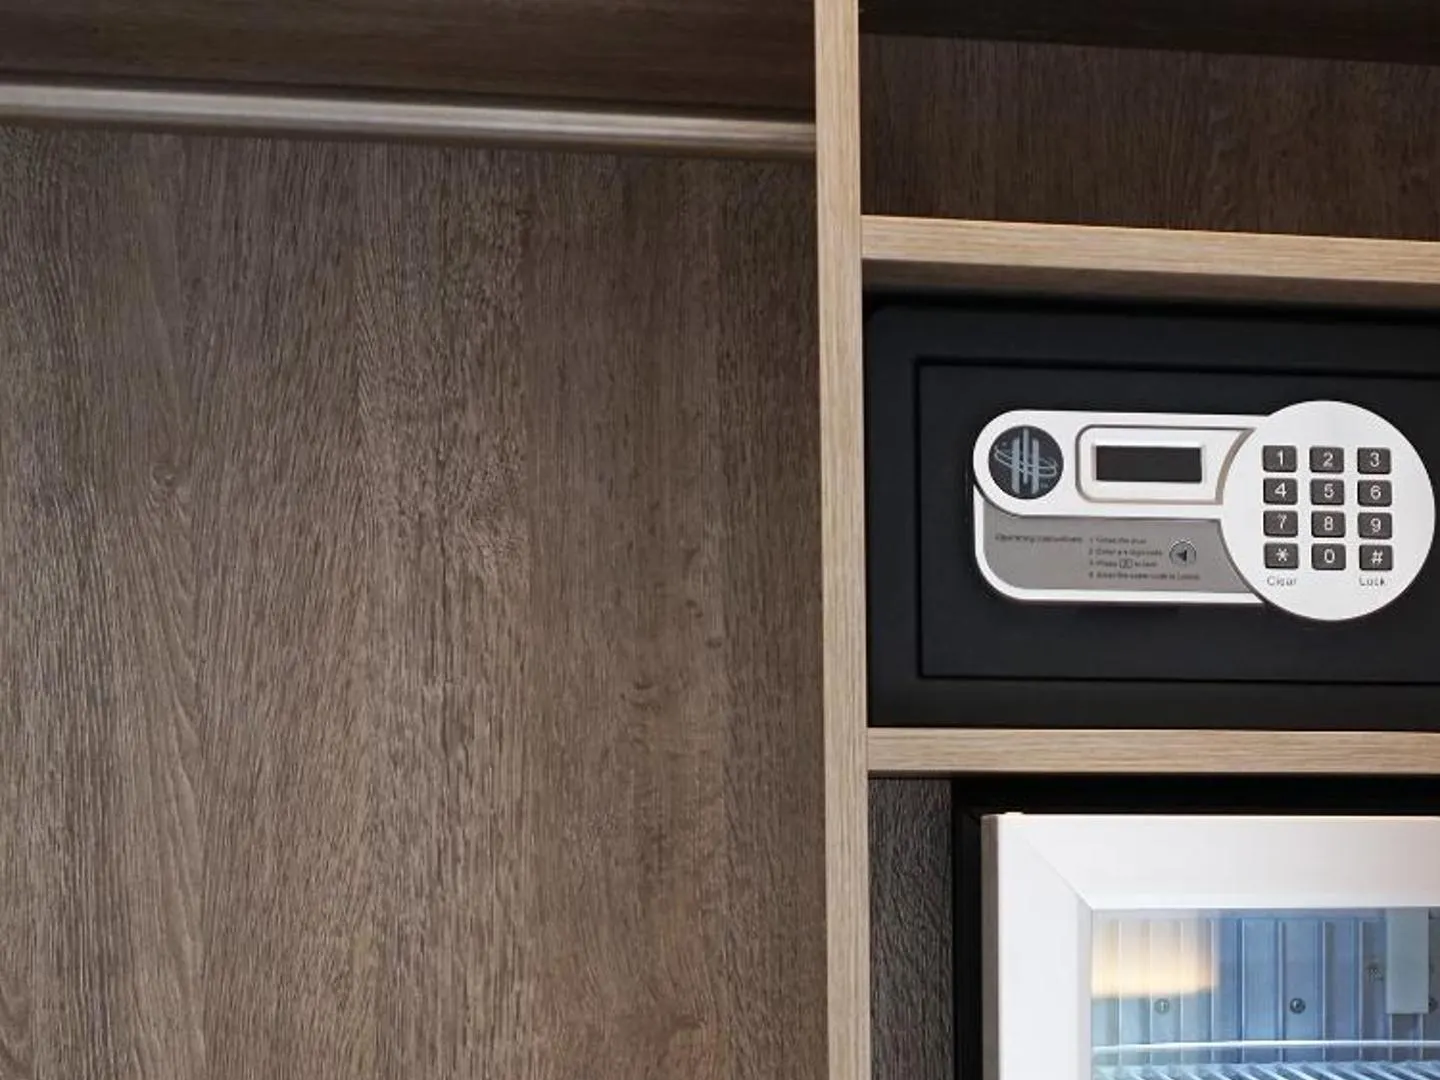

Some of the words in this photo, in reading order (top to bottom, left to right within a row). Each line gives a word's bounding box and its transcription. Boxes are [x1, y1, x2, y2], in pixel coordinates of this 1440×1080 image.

[1277, 450, 1285, 467] 1
[1322, 452, 1334, 468] 2
[1369, 452, 1381, 468] 3
[1274, 482, 1288, 498] 4
[1323, 483, 1336, 499] 5
[1369, 485, 1382, 500] 6
[1277, 513, 1288, 530] 7
[1323, 515, 1335, 531] 8
[1370, 517, 1382, 533] 9
[1323, 548, 1336, 564] 0
